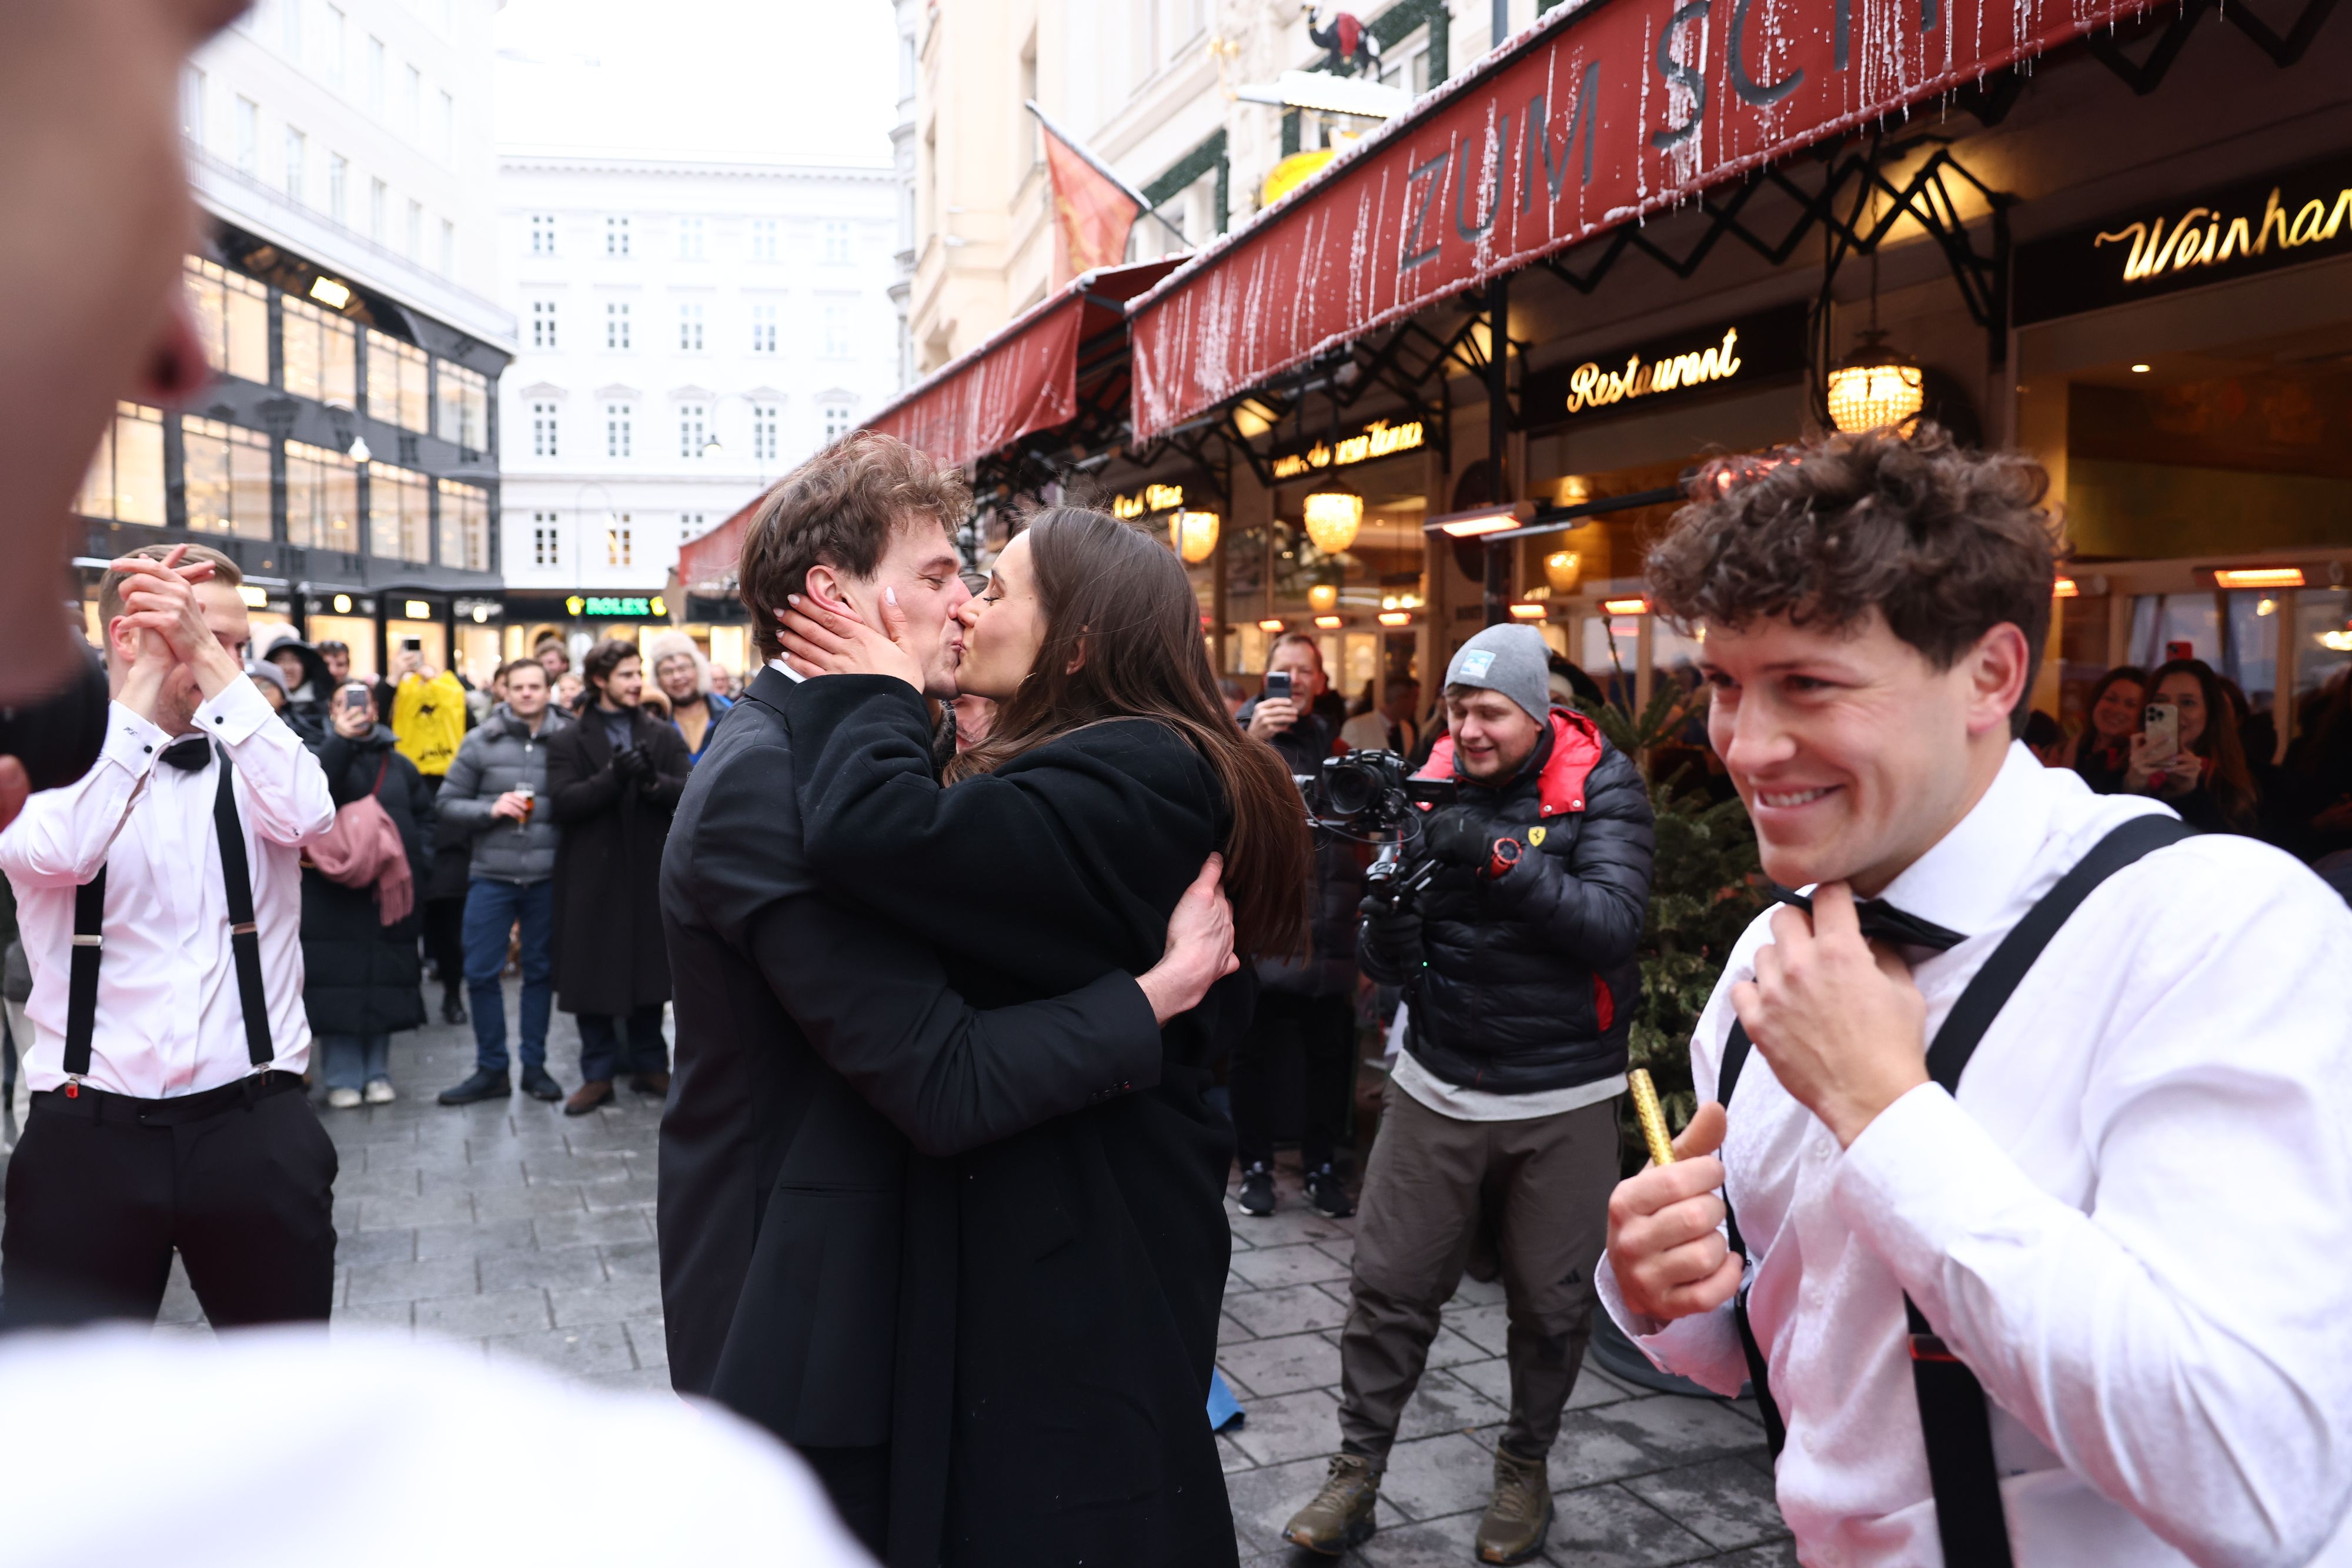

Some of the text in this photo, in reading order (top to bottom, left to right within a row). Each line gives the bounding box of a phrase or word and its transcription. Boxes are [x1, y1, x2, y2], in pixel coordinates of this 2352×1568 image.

[1400, 61, 1600, 274] ZUM
[1566, 327, 1741, 413] Restaurant
[585, 597, 649, 615] ROLEX
